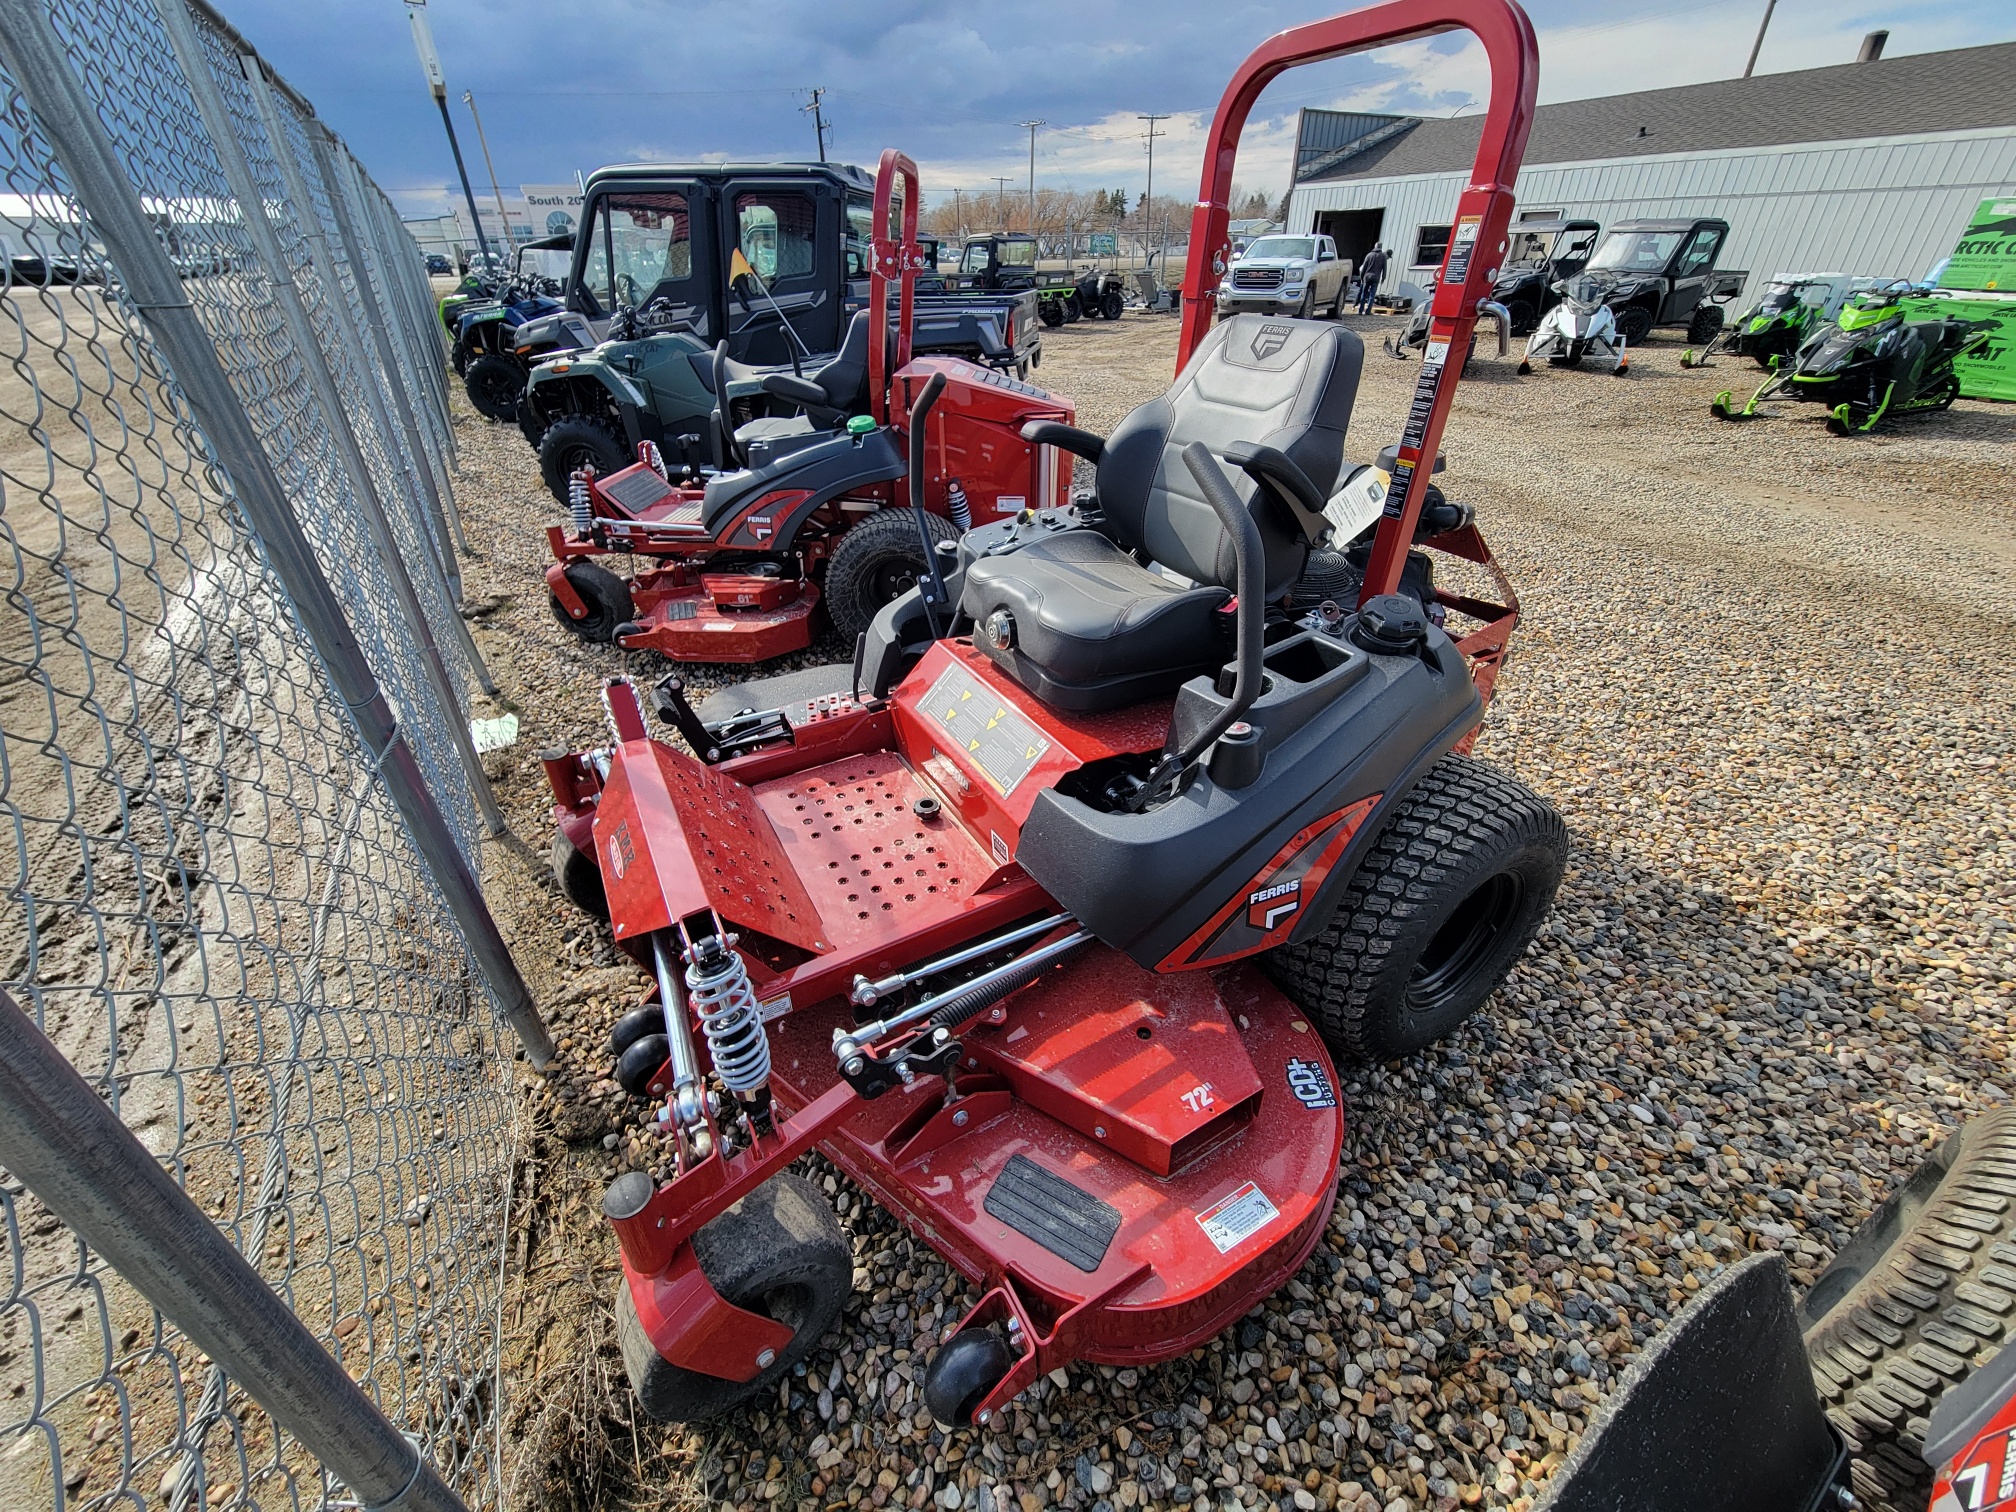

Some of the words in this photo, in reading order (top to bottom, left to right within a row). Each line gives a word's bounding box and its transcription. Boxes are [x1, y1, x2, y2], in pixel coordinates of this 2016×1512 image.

[528, 195, 564, 206] South
[473, 311, 503, 320] ALTERRA
[1262, 325, 1292, 335] FERRIS
[1963, 363, 2006, 371] SNOWMOBILES
[747, 516, 771, 524] FERRIS
[1250, 879, 1299, 905] FERRIS
[1311, 1062, 1336, 1106] CUTTING
[1219, 1194, 1240, 1210] DANGER
